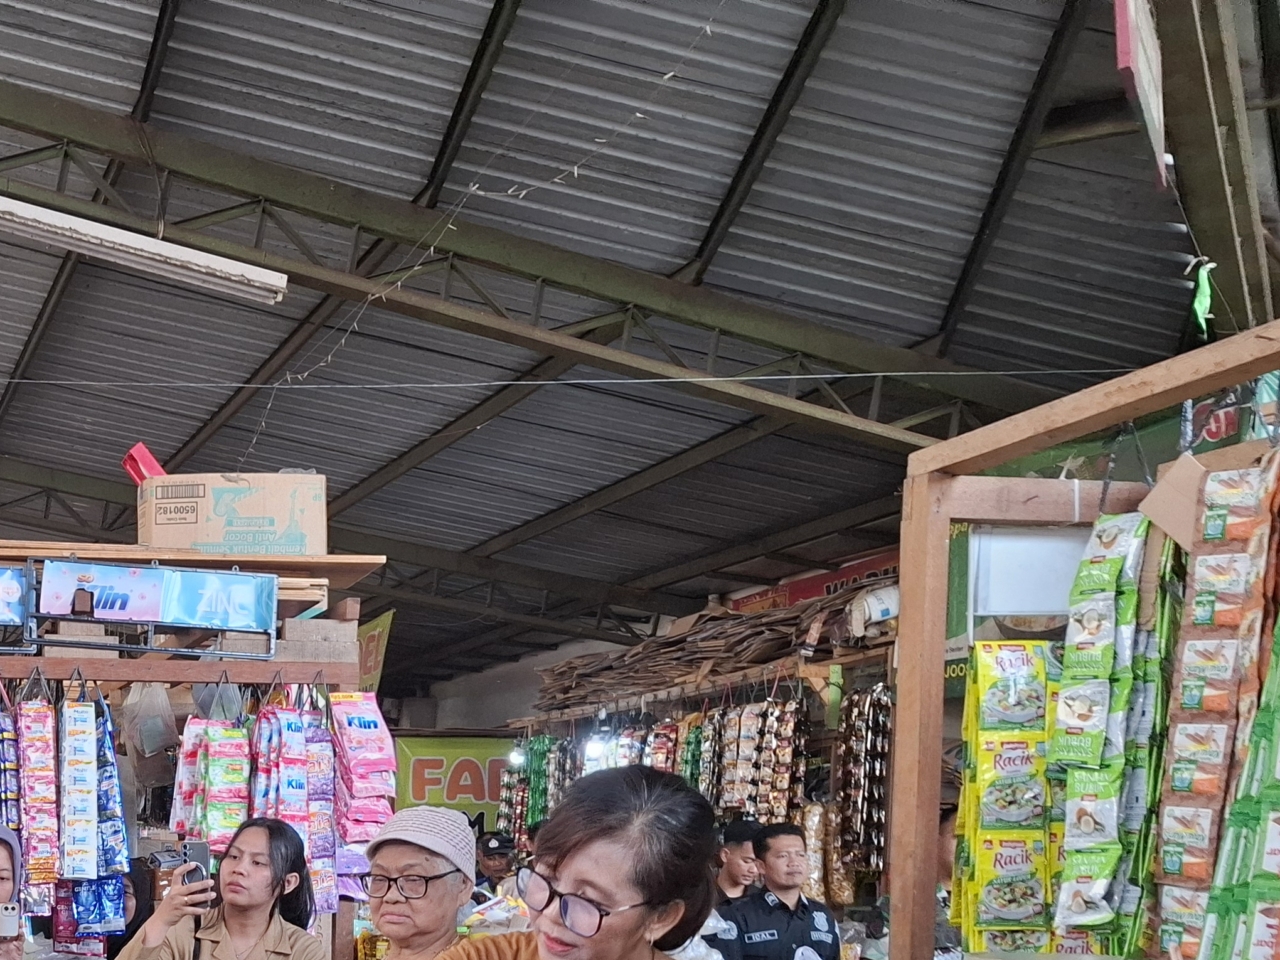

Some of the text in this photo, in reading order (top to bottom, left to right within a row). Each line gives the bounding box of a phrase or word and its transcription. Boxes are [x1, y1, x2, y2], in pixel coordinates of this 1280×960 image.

[156, 505, 196, 515] 6500182
[224, 533, 276, 542] Anti Bocor
[232, 544, 267, 554] Bentuk
[268, 544, 306, 554] Kembali
[287, 722, 303, 733] Klin
[347, 714, 379, 730] Klin
[993, 750, 1034, 770] Racik
[287, 778, 305, 790] Klin
[993, 849, 1034, 868] Racik
